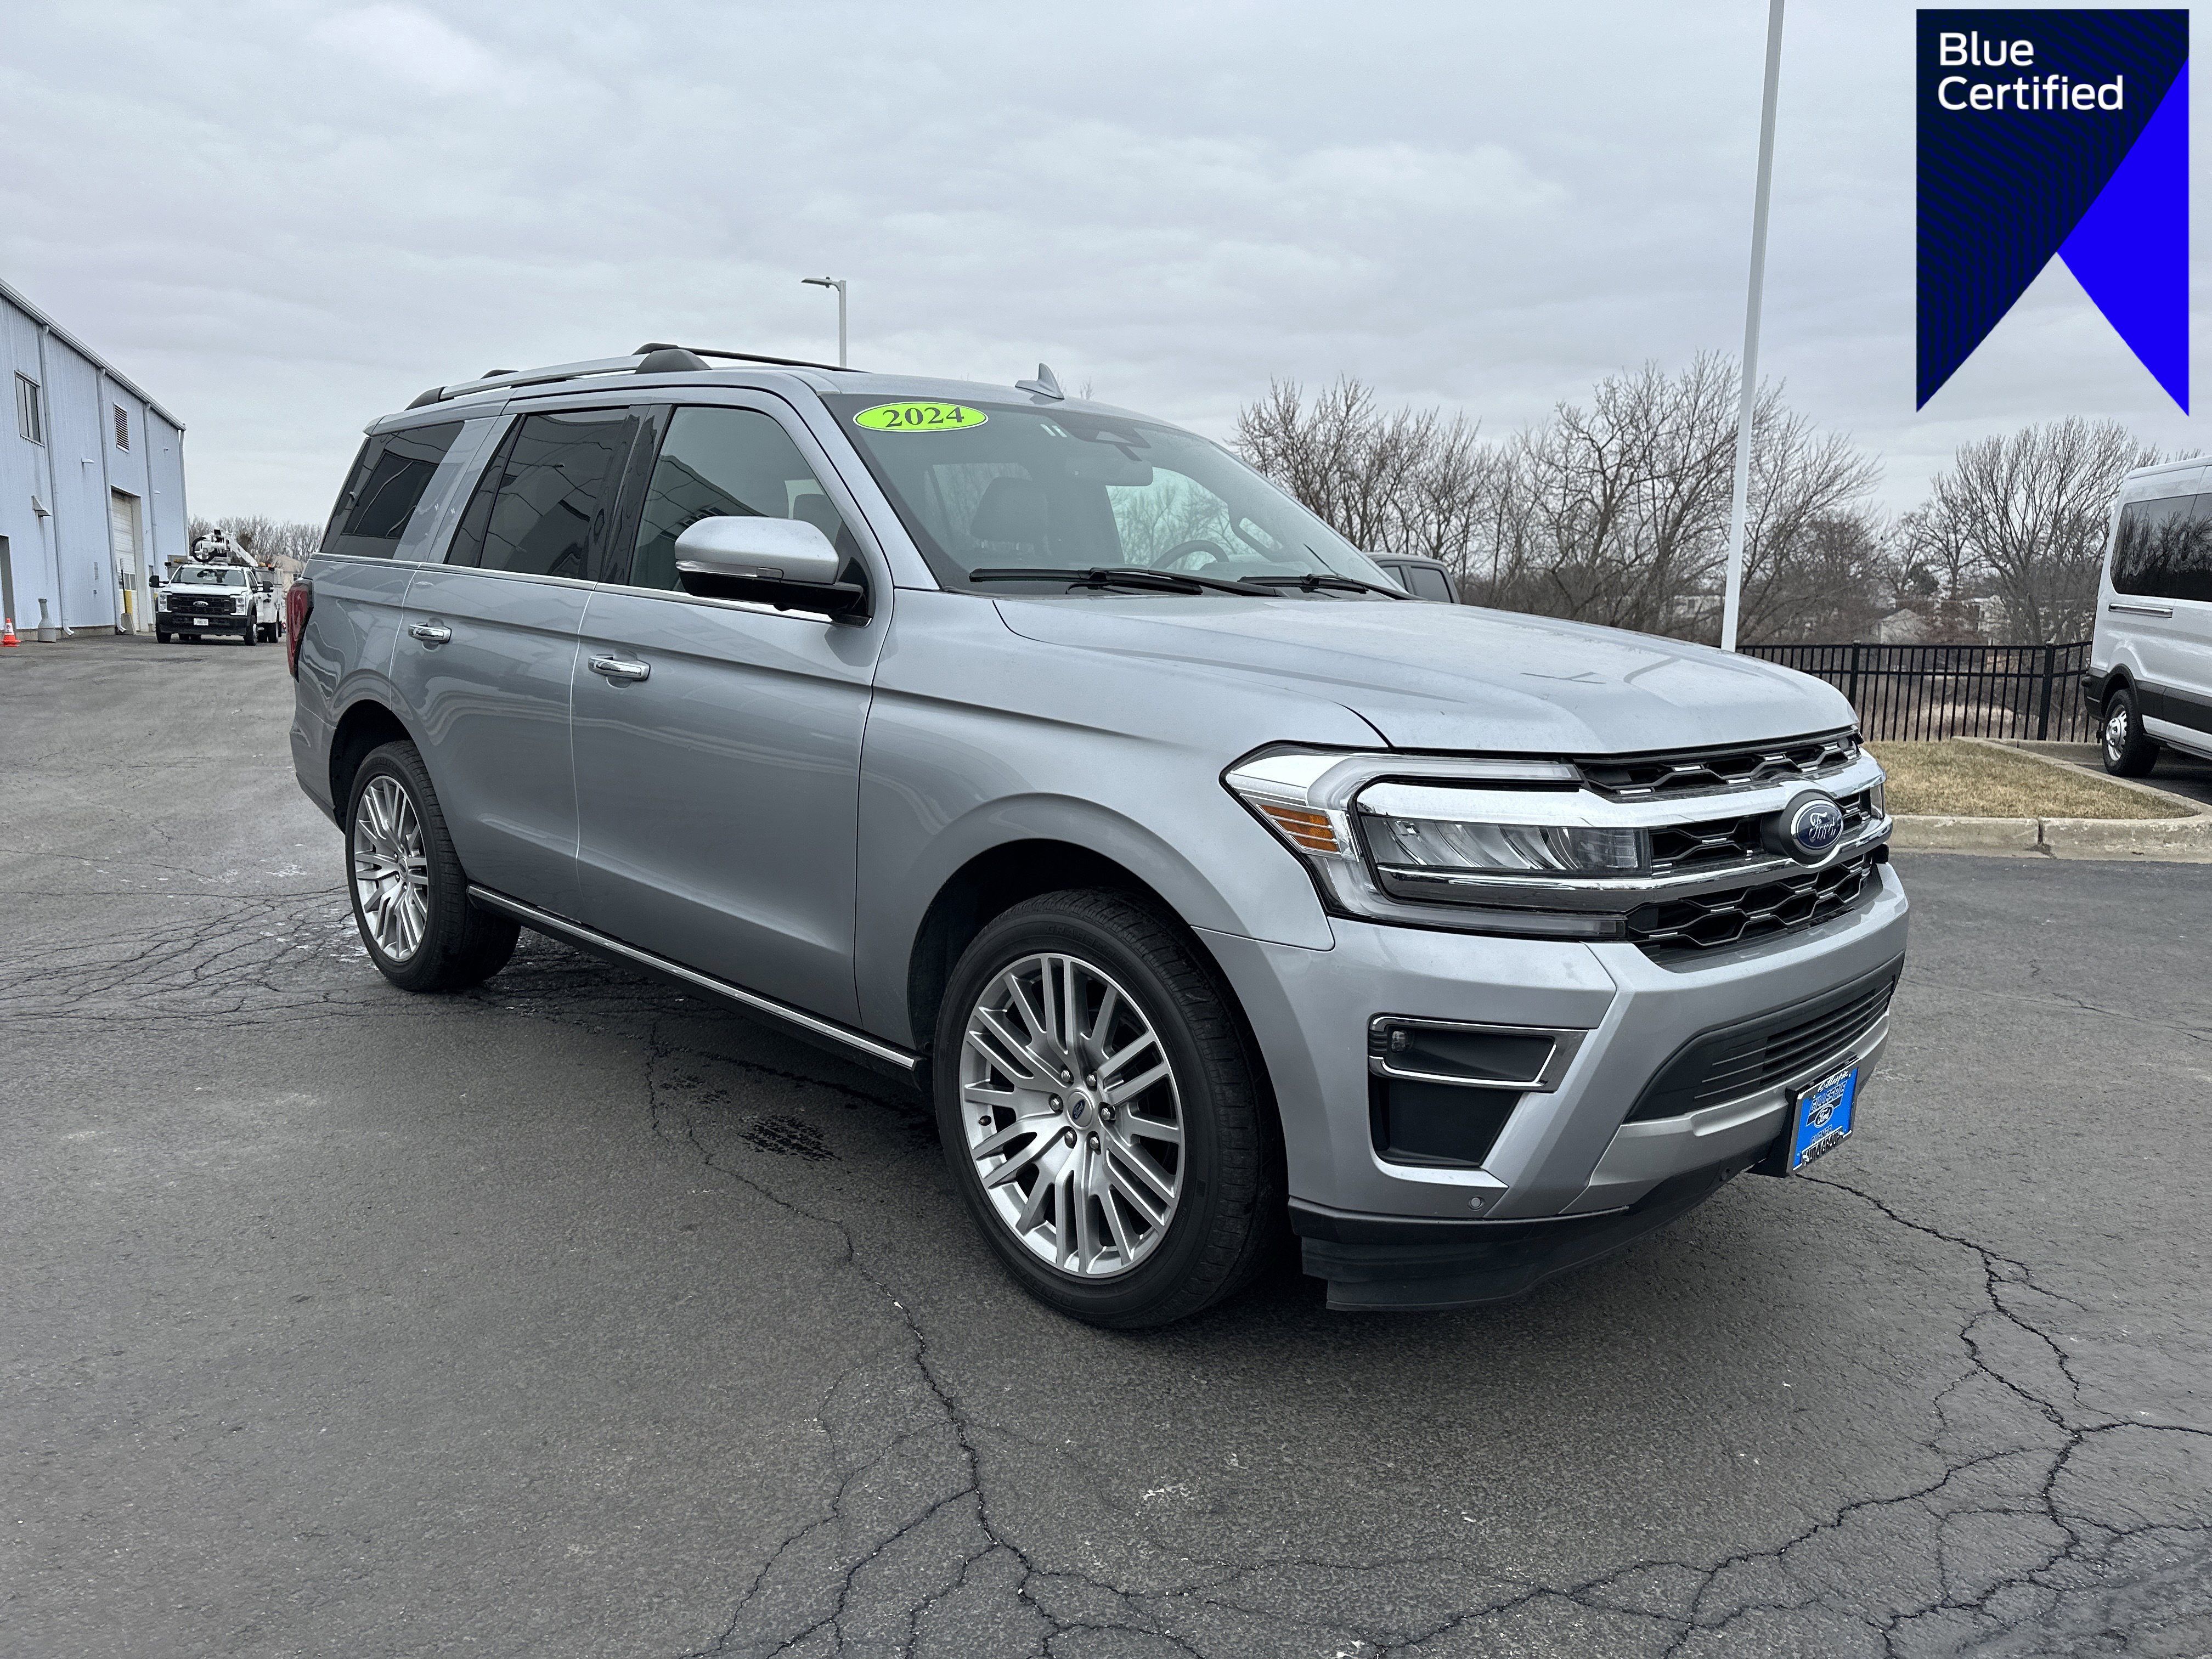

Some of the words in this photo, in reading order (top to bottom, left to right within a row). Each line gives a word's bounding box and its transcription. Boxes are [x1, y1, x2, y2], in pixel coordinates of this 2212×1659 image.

[883, 407, 964, 427] 2024
[1809, 811, 1836, 841] Ford
[1810, 1080, 1847, 1113] GILLESPIE
[1817, 1108, 1831, 1125] Ford
